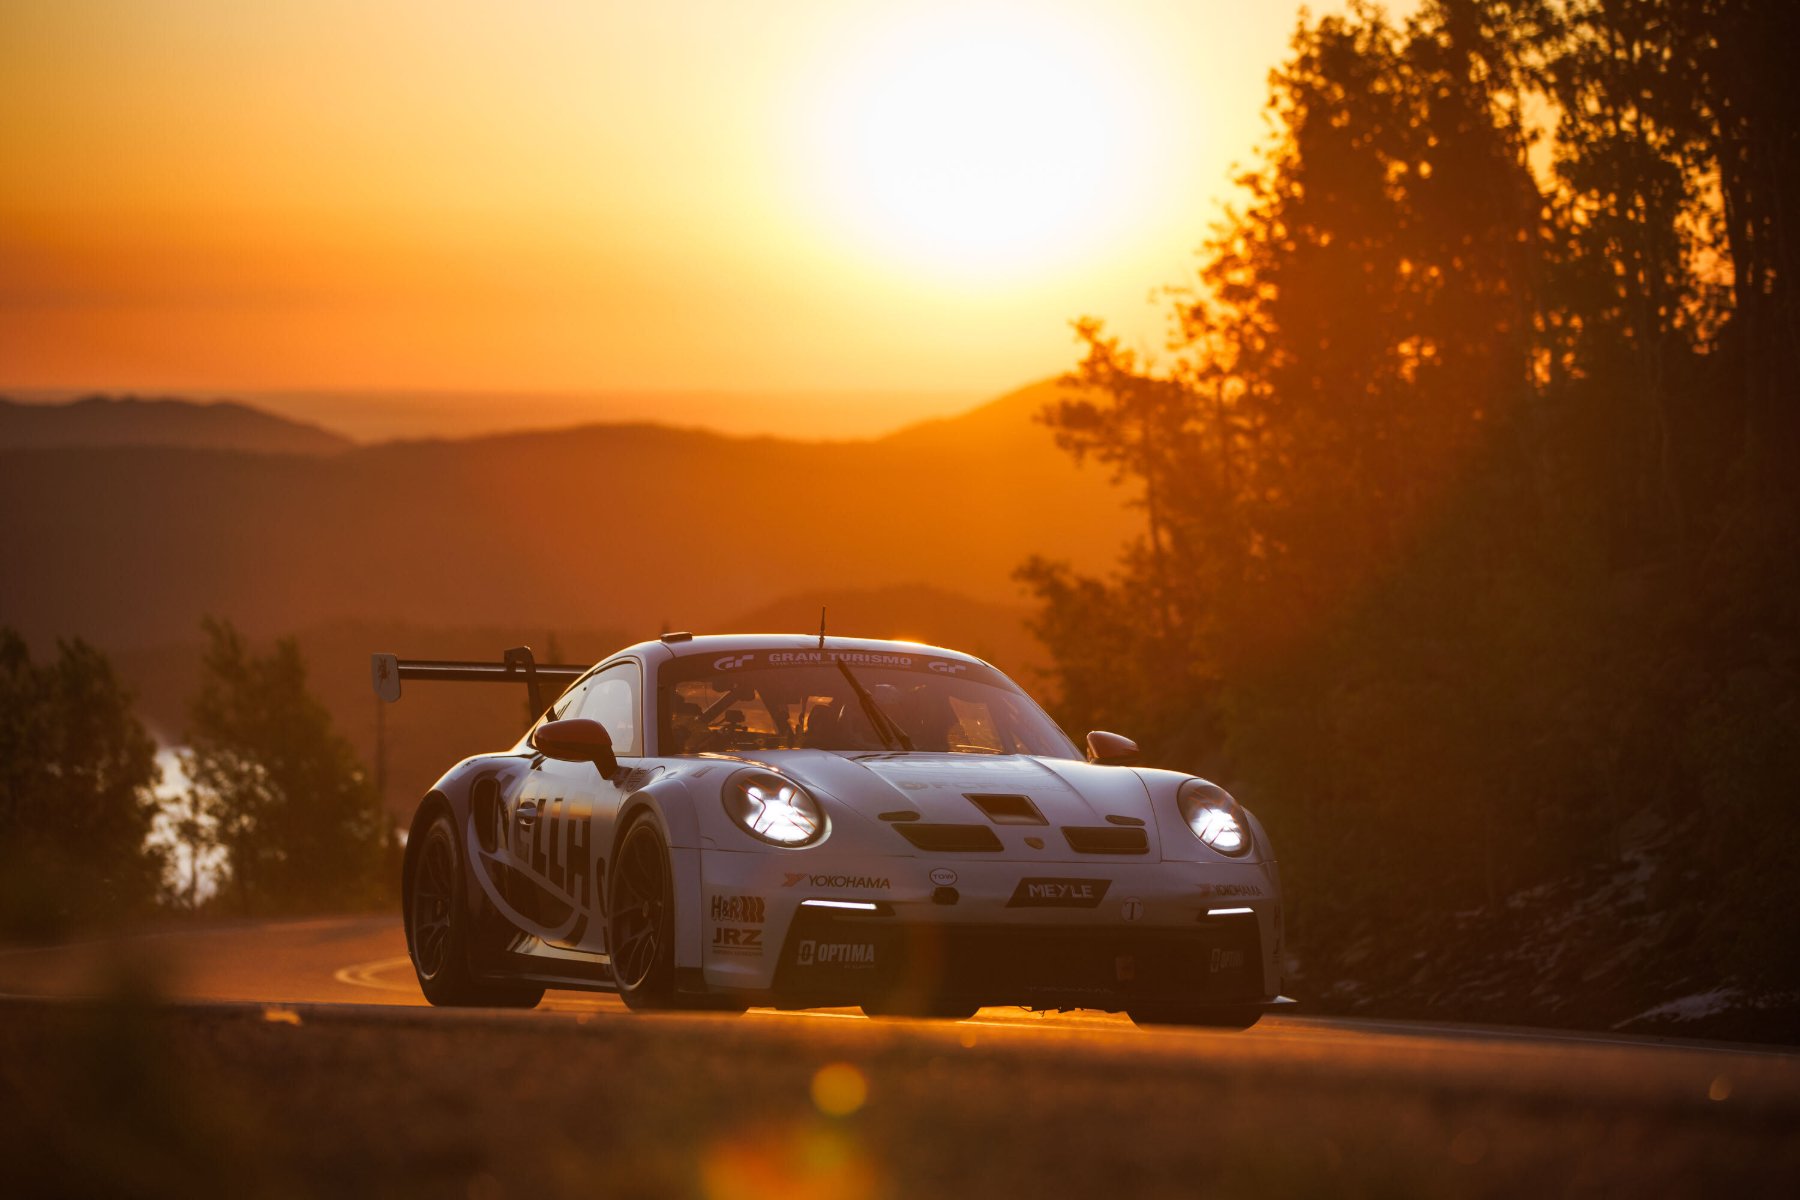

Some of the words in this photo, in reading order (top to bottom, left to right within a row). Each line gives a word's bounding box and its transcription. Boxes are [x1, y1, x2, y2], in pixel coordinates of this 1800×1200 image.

[768, 652, 821, 662] GRAN
[827, 652, 912, 665] TURISMO
[808, 874, 891, 889] YOKOHAMA
[932, 872, 954, 880] TOW
[1028, 884, 1094, 898] MEYLE
[712, 927, 763, 946] JRZ
[818, 943, 875, 962] OPTIMA
